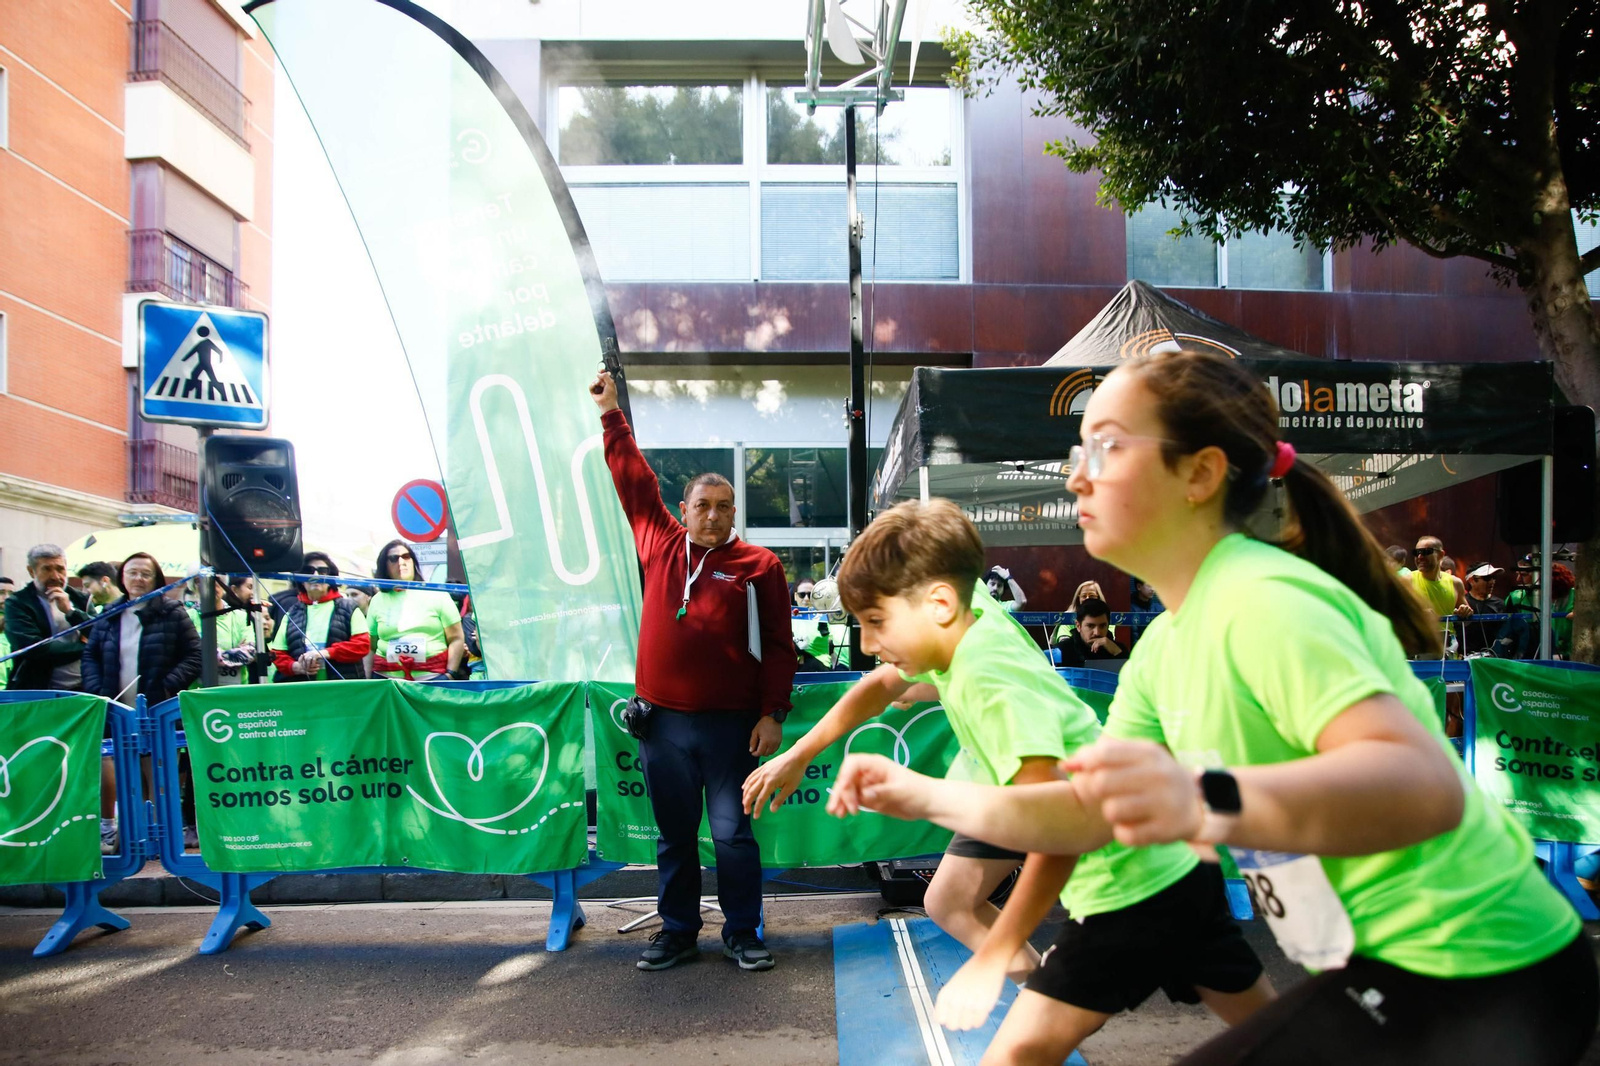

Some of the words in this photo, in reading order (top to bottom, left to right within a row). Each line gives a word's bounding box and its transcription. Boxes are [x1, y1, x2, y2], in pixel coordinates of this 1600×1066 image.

[1278, 415, 1341, 429] metraje
[1346, 415, 1424, 429] deportivo
[394, 644, 418, 655] 532
[237, 708, 283, 719] asociación
[238, 719, 277, 730] española
[238, 730, 267, 739] contra
[268, 728, 277, 738] el
[277, 728, 307, 738] cáncer
[1495, 730, 1579, 759] Contra
[207, 761, 294, 783] Contra
[300, 757, 325, 779] el
[330, 754, 414, 777] cáncer
[1494, 756, 1574, 780] somos
[208, 789, 292, 808] somos
[298, 781, 354, 804] solo
[361, 782, 402, 799] uno
